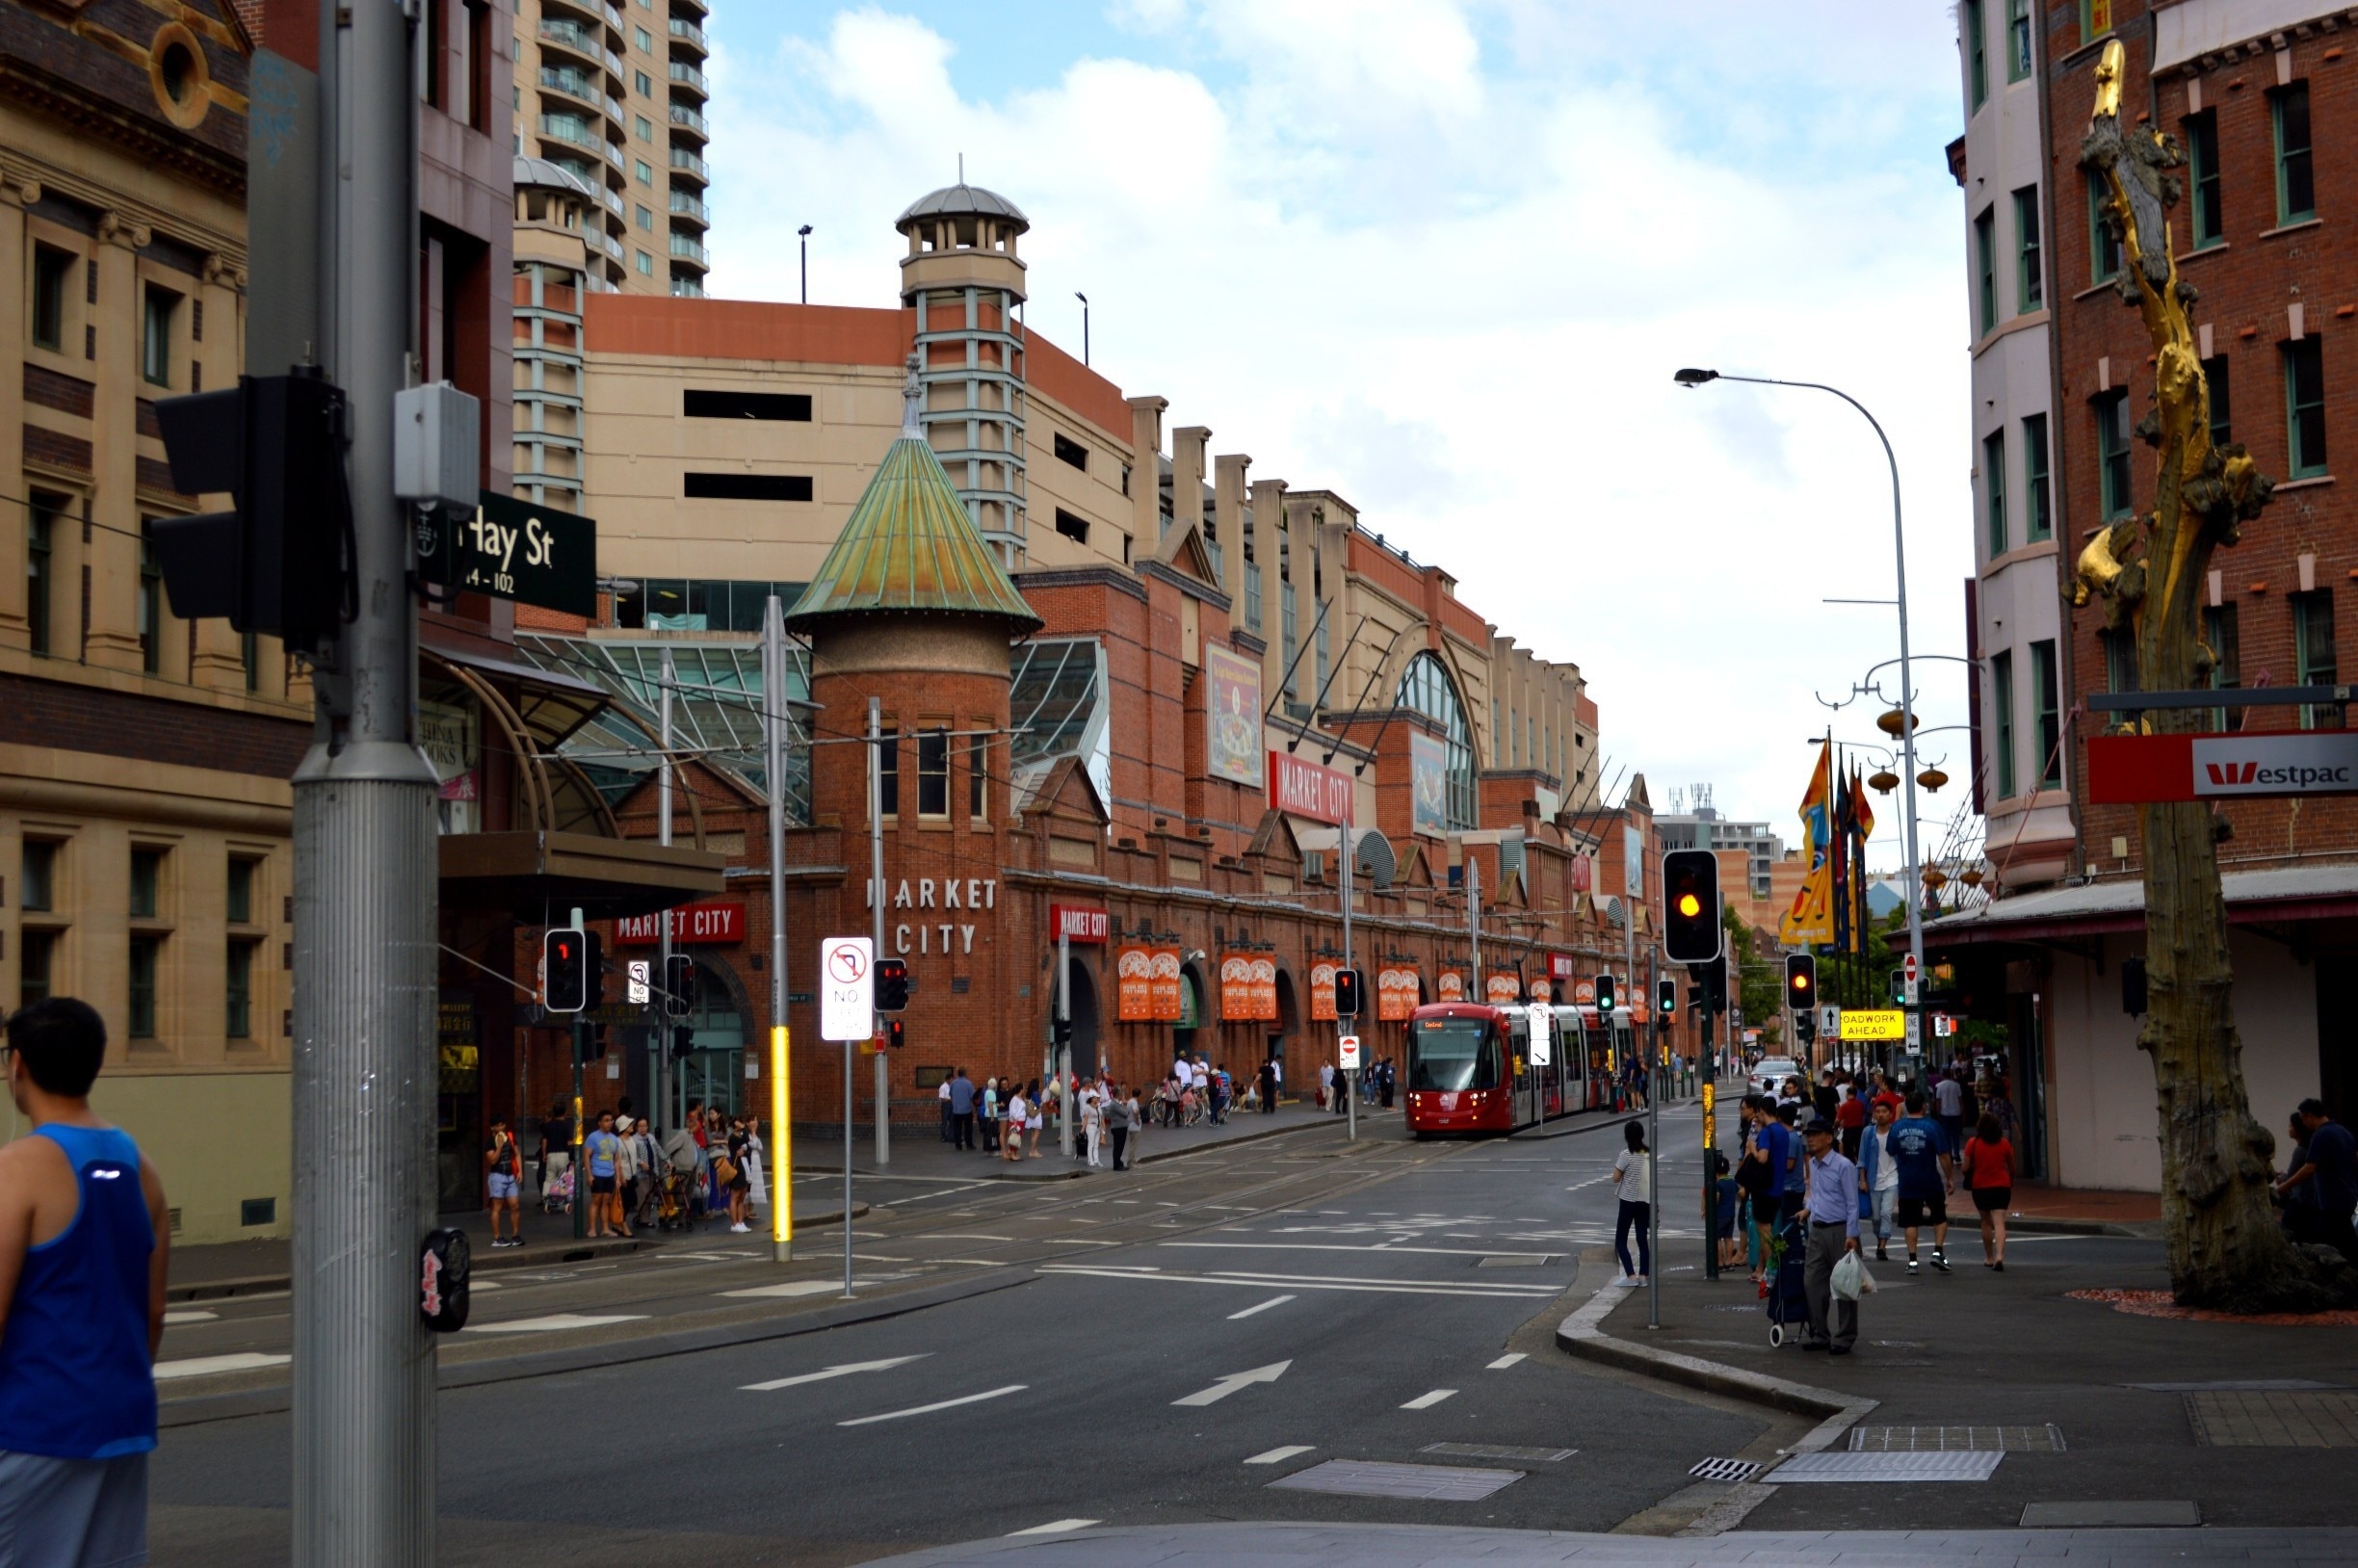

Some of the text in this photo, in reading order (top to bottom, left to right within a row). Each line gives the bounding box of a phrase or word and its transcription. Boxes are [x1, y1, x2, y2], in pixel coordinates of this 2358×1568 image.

[458, 505, 555, 573] Hay St
[494, 572, 514, 593] 102
[419, 721, 455, 745] HINA
[422, 744, 457, 766] OOKS
[2206, 762, 2349, 788] Westpac
[1281, 761, 1349, 820] MARKET CITY
[694, 909, 731, 935] CITY
[1061, 909, 1108, 937] MARKET CITY
[896, 924, 975, 954] CITY
[633, 986, 644, 995] NO
[834, 989, 858, 1003] NO
[1908, 984, 1915, 993] NO
[1841, 1014, 1897, 1024] OADWORK
[1907, 1017, 1918, 1028] ONE
[1847, 1026, 1886, 1035] AHEAD
[1908, 1030, 1918, 1039] WAY
